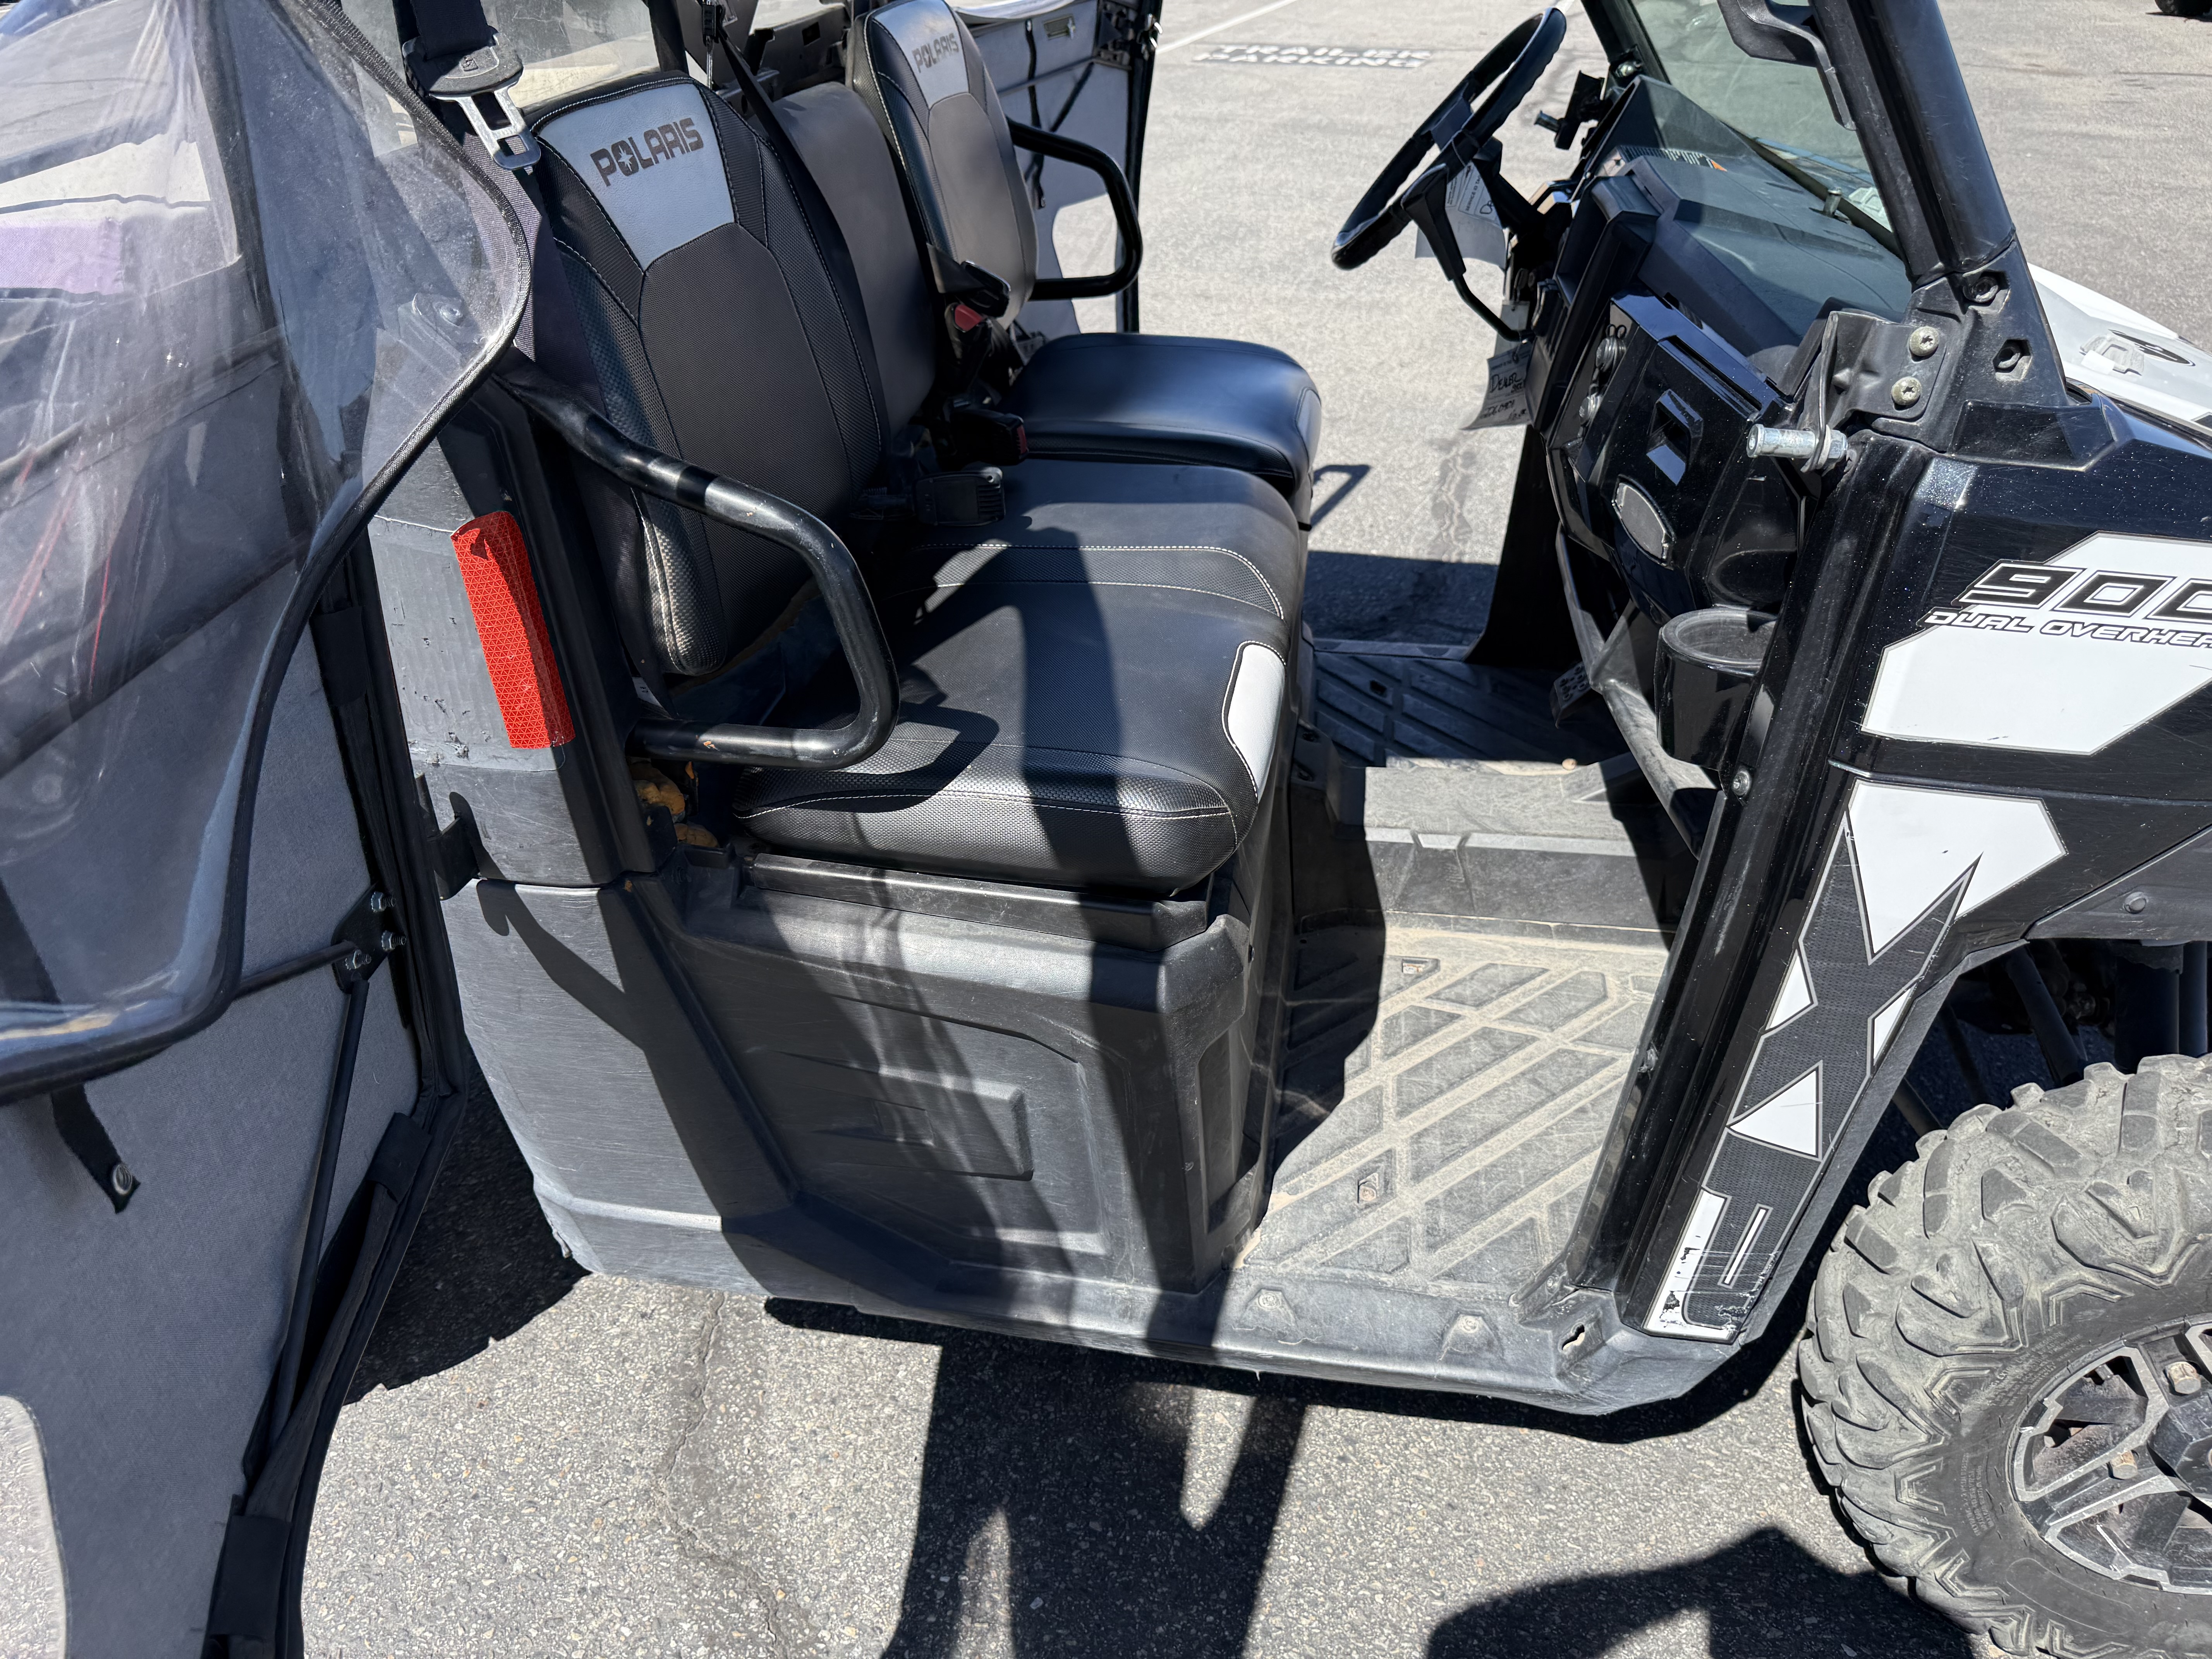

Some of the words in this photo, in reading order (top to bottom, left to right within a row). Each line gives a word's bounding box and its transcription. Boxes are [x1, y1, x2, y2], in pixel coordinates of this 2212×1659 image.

[911, 33, 959, 73] POLARIS
[1193, 52, 1425, 67] PARKING
[1219, 45, 1431, 59] TRAILER
[591, 117, 704, 186] POLARIS
[1924, 610, 2034, 632] DUAL
